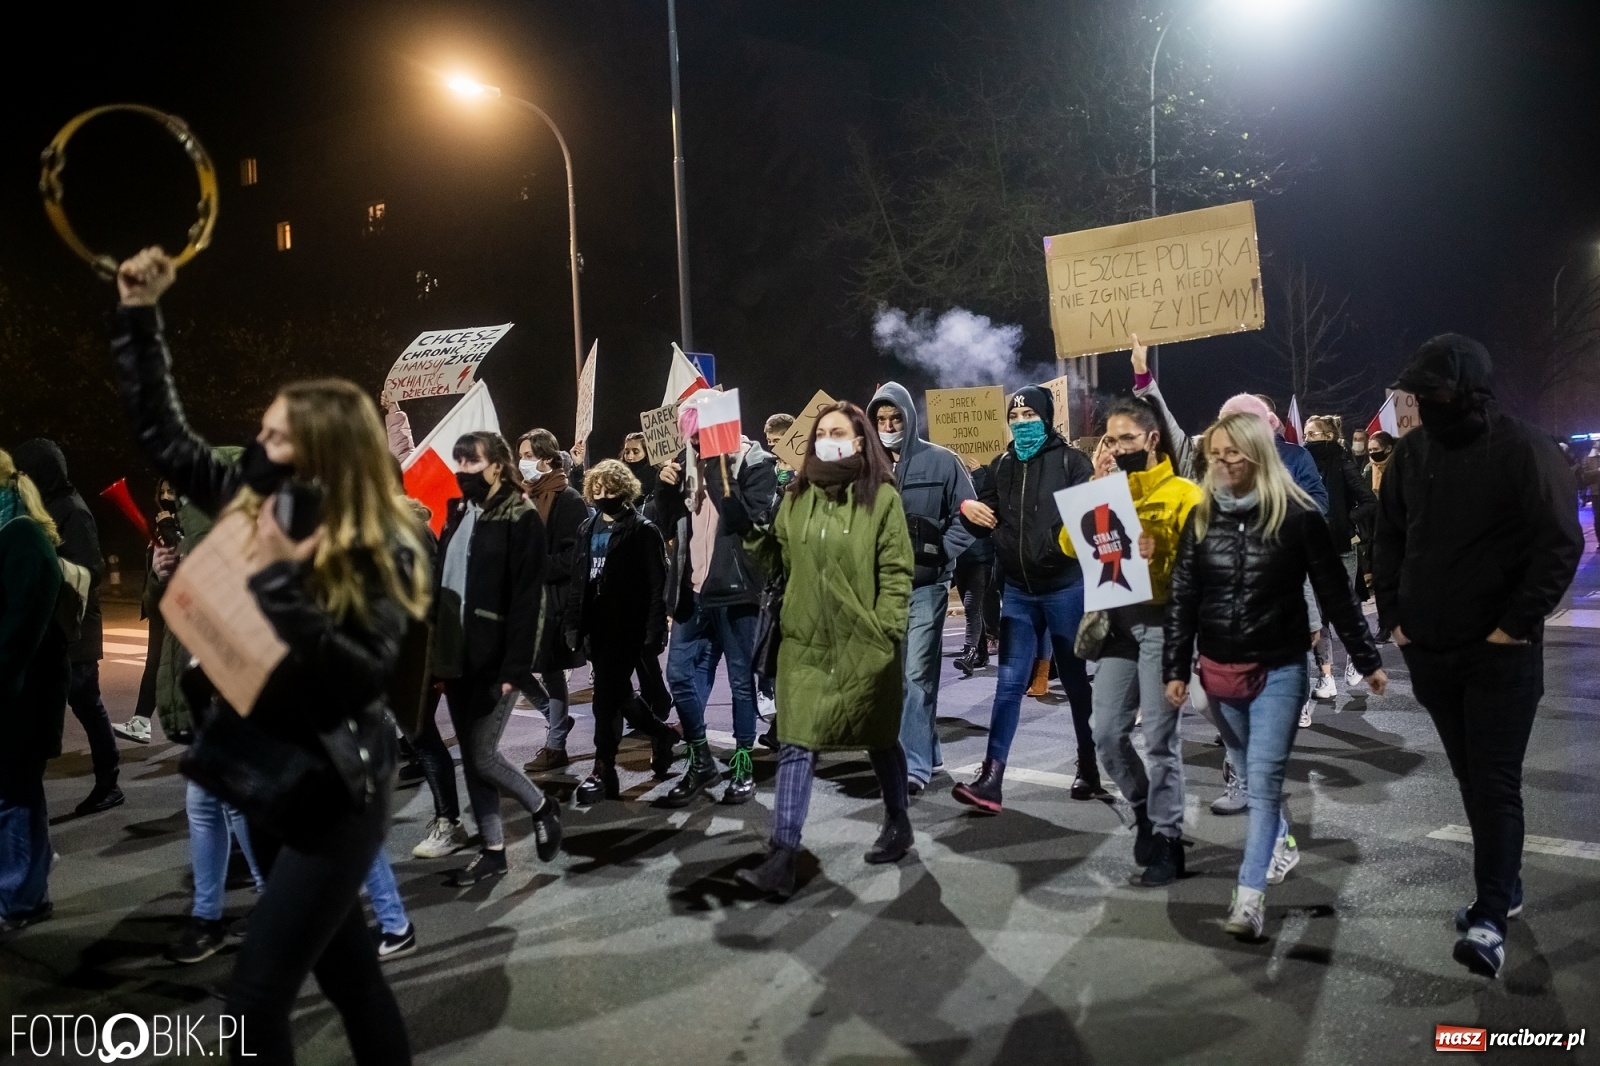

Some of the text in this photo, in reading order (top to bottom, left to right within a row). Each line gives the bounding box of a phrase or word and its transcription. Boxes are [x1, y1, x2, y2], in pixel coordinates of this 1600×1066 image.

[1058, 237, 1253, 291] JESZCZE POLSKA
[1060, 292, 1084, 309] NIE
[1176, 268, 1224, 290] KIEDY
[1089, 306, 1131, 340] MY
[391, 358, 446, 376] FINANSUJ
[949, 396, 977, 409] JAREK
[1013, 395, 1026, 408] NY
[935, 409, 998, 425] KOBIETA TO NIE
[952, 426, 979, 439] JAJKO
